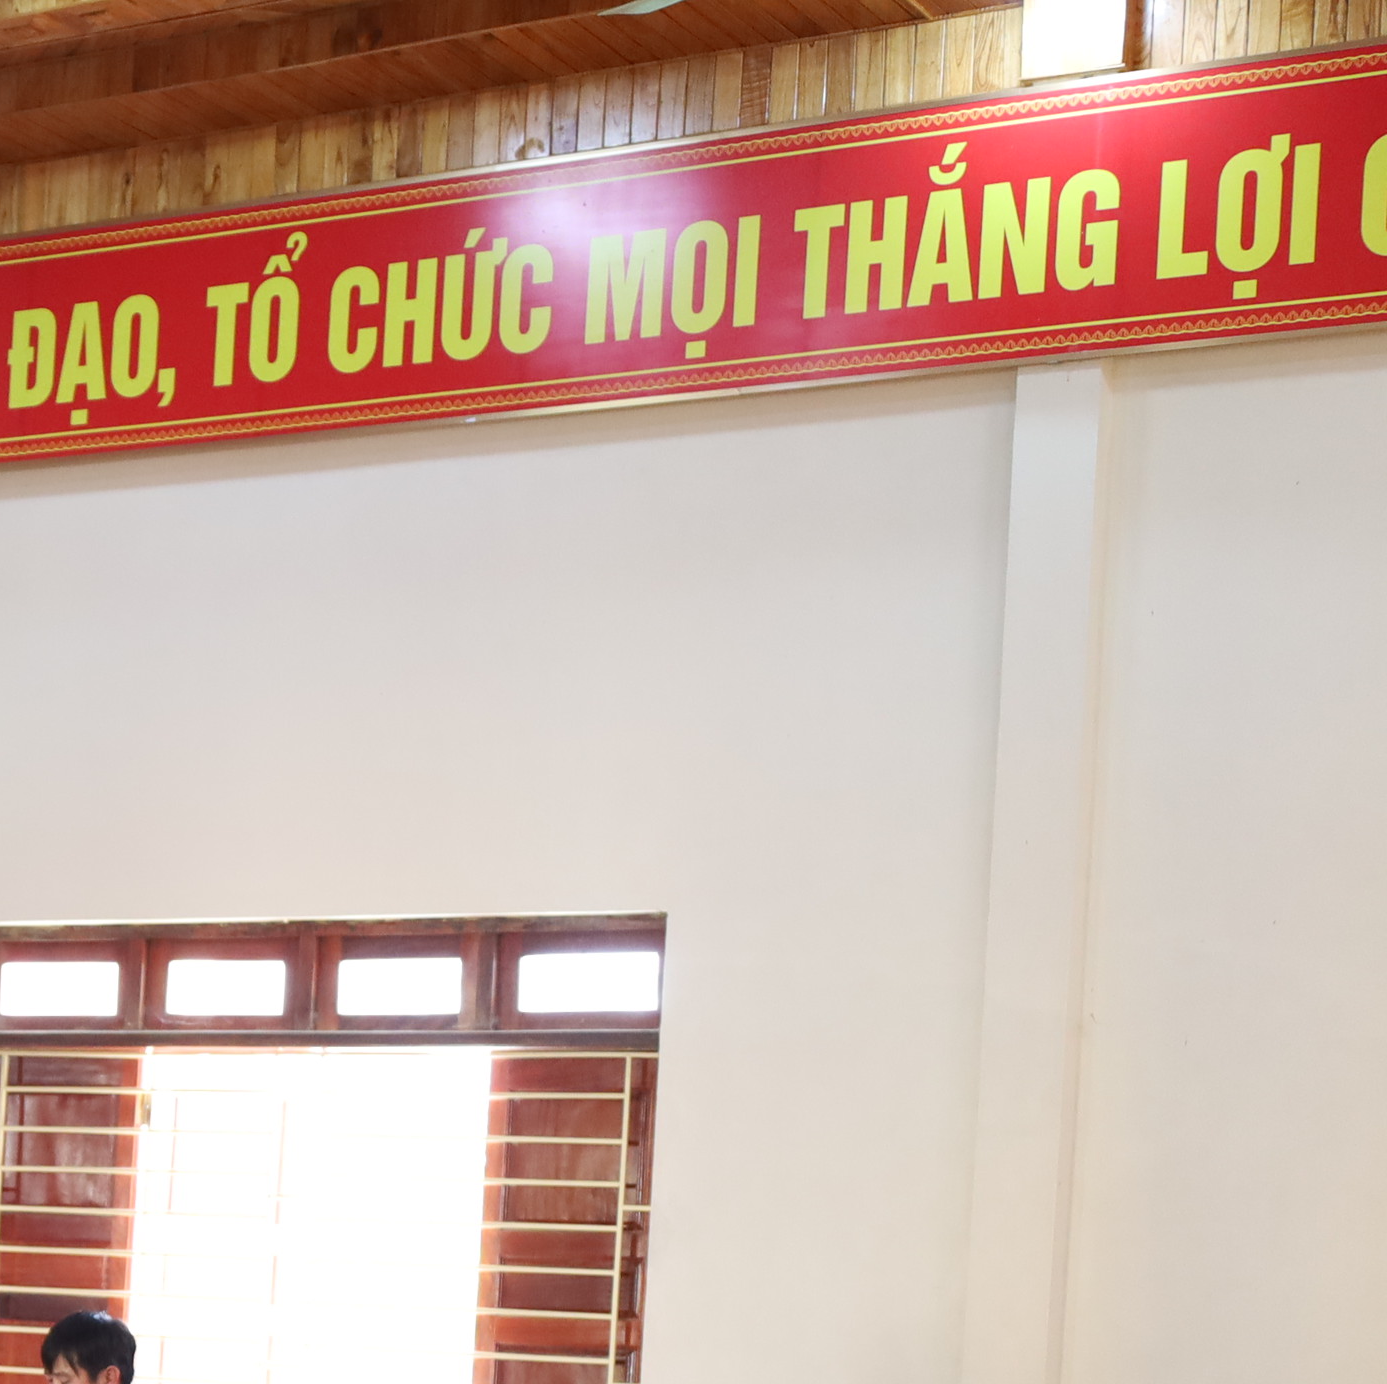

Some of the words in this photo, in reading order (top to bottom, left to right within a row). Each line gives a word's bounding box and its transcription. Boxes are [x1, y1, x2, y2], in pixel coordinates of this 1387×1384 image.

[6, 294, 177, 427] ĐẠO,
[205, 231, 310, 387] TỔ
[327, 227, 553, 374] CHỨC
[583, 215, 762, 359] MỌI
[794, 141, 1122, 319] THẮNG
[1155, 132, 1322, 300] LỢI
